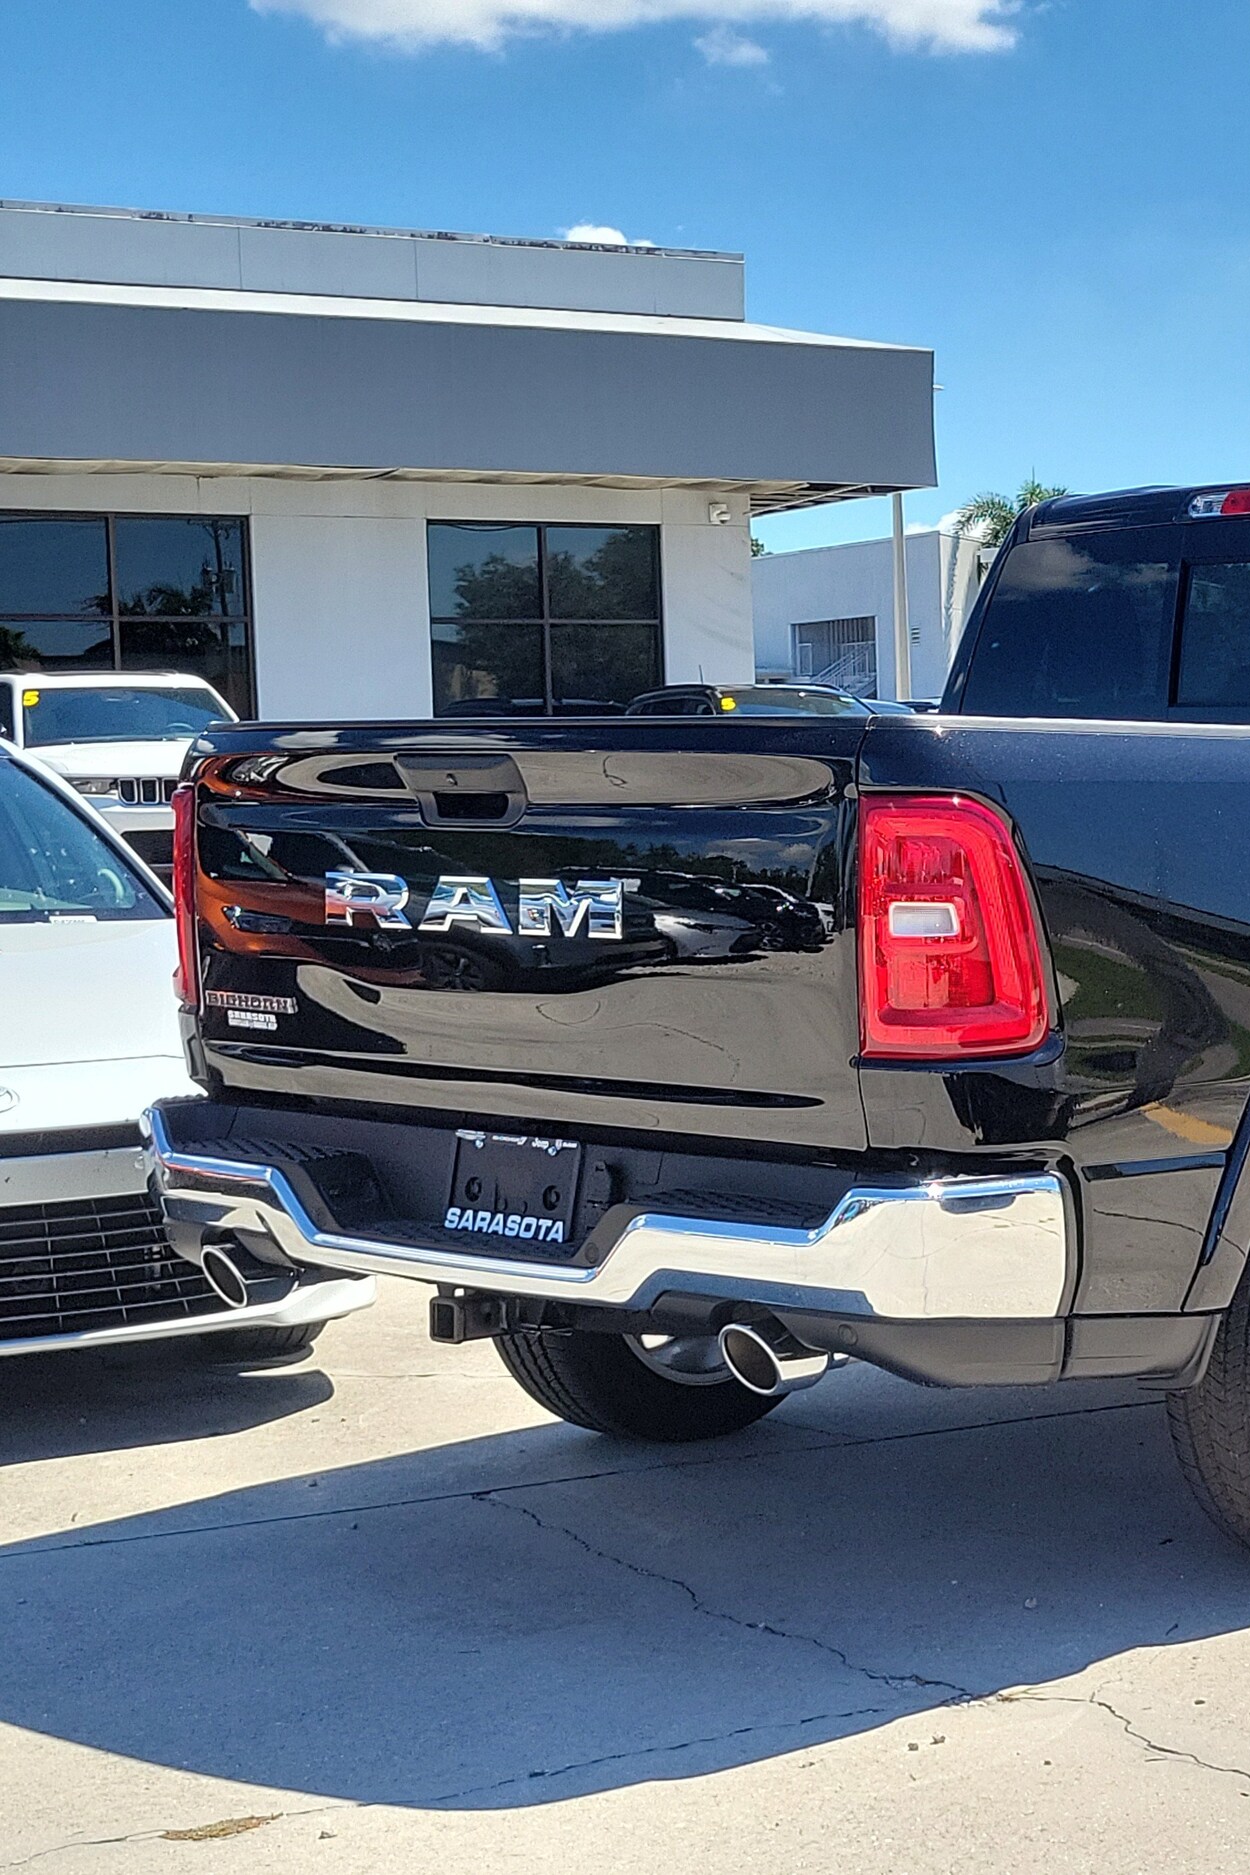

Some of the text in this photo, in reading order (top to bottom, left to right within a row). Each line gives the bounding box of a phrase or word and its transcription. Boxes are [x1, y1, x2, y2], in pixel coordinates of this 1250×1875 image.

[23, 690, 39, 706] 5
[325, 871, 623, 939] RAM
[444, 1207, 564, 1243] SARASOTA
